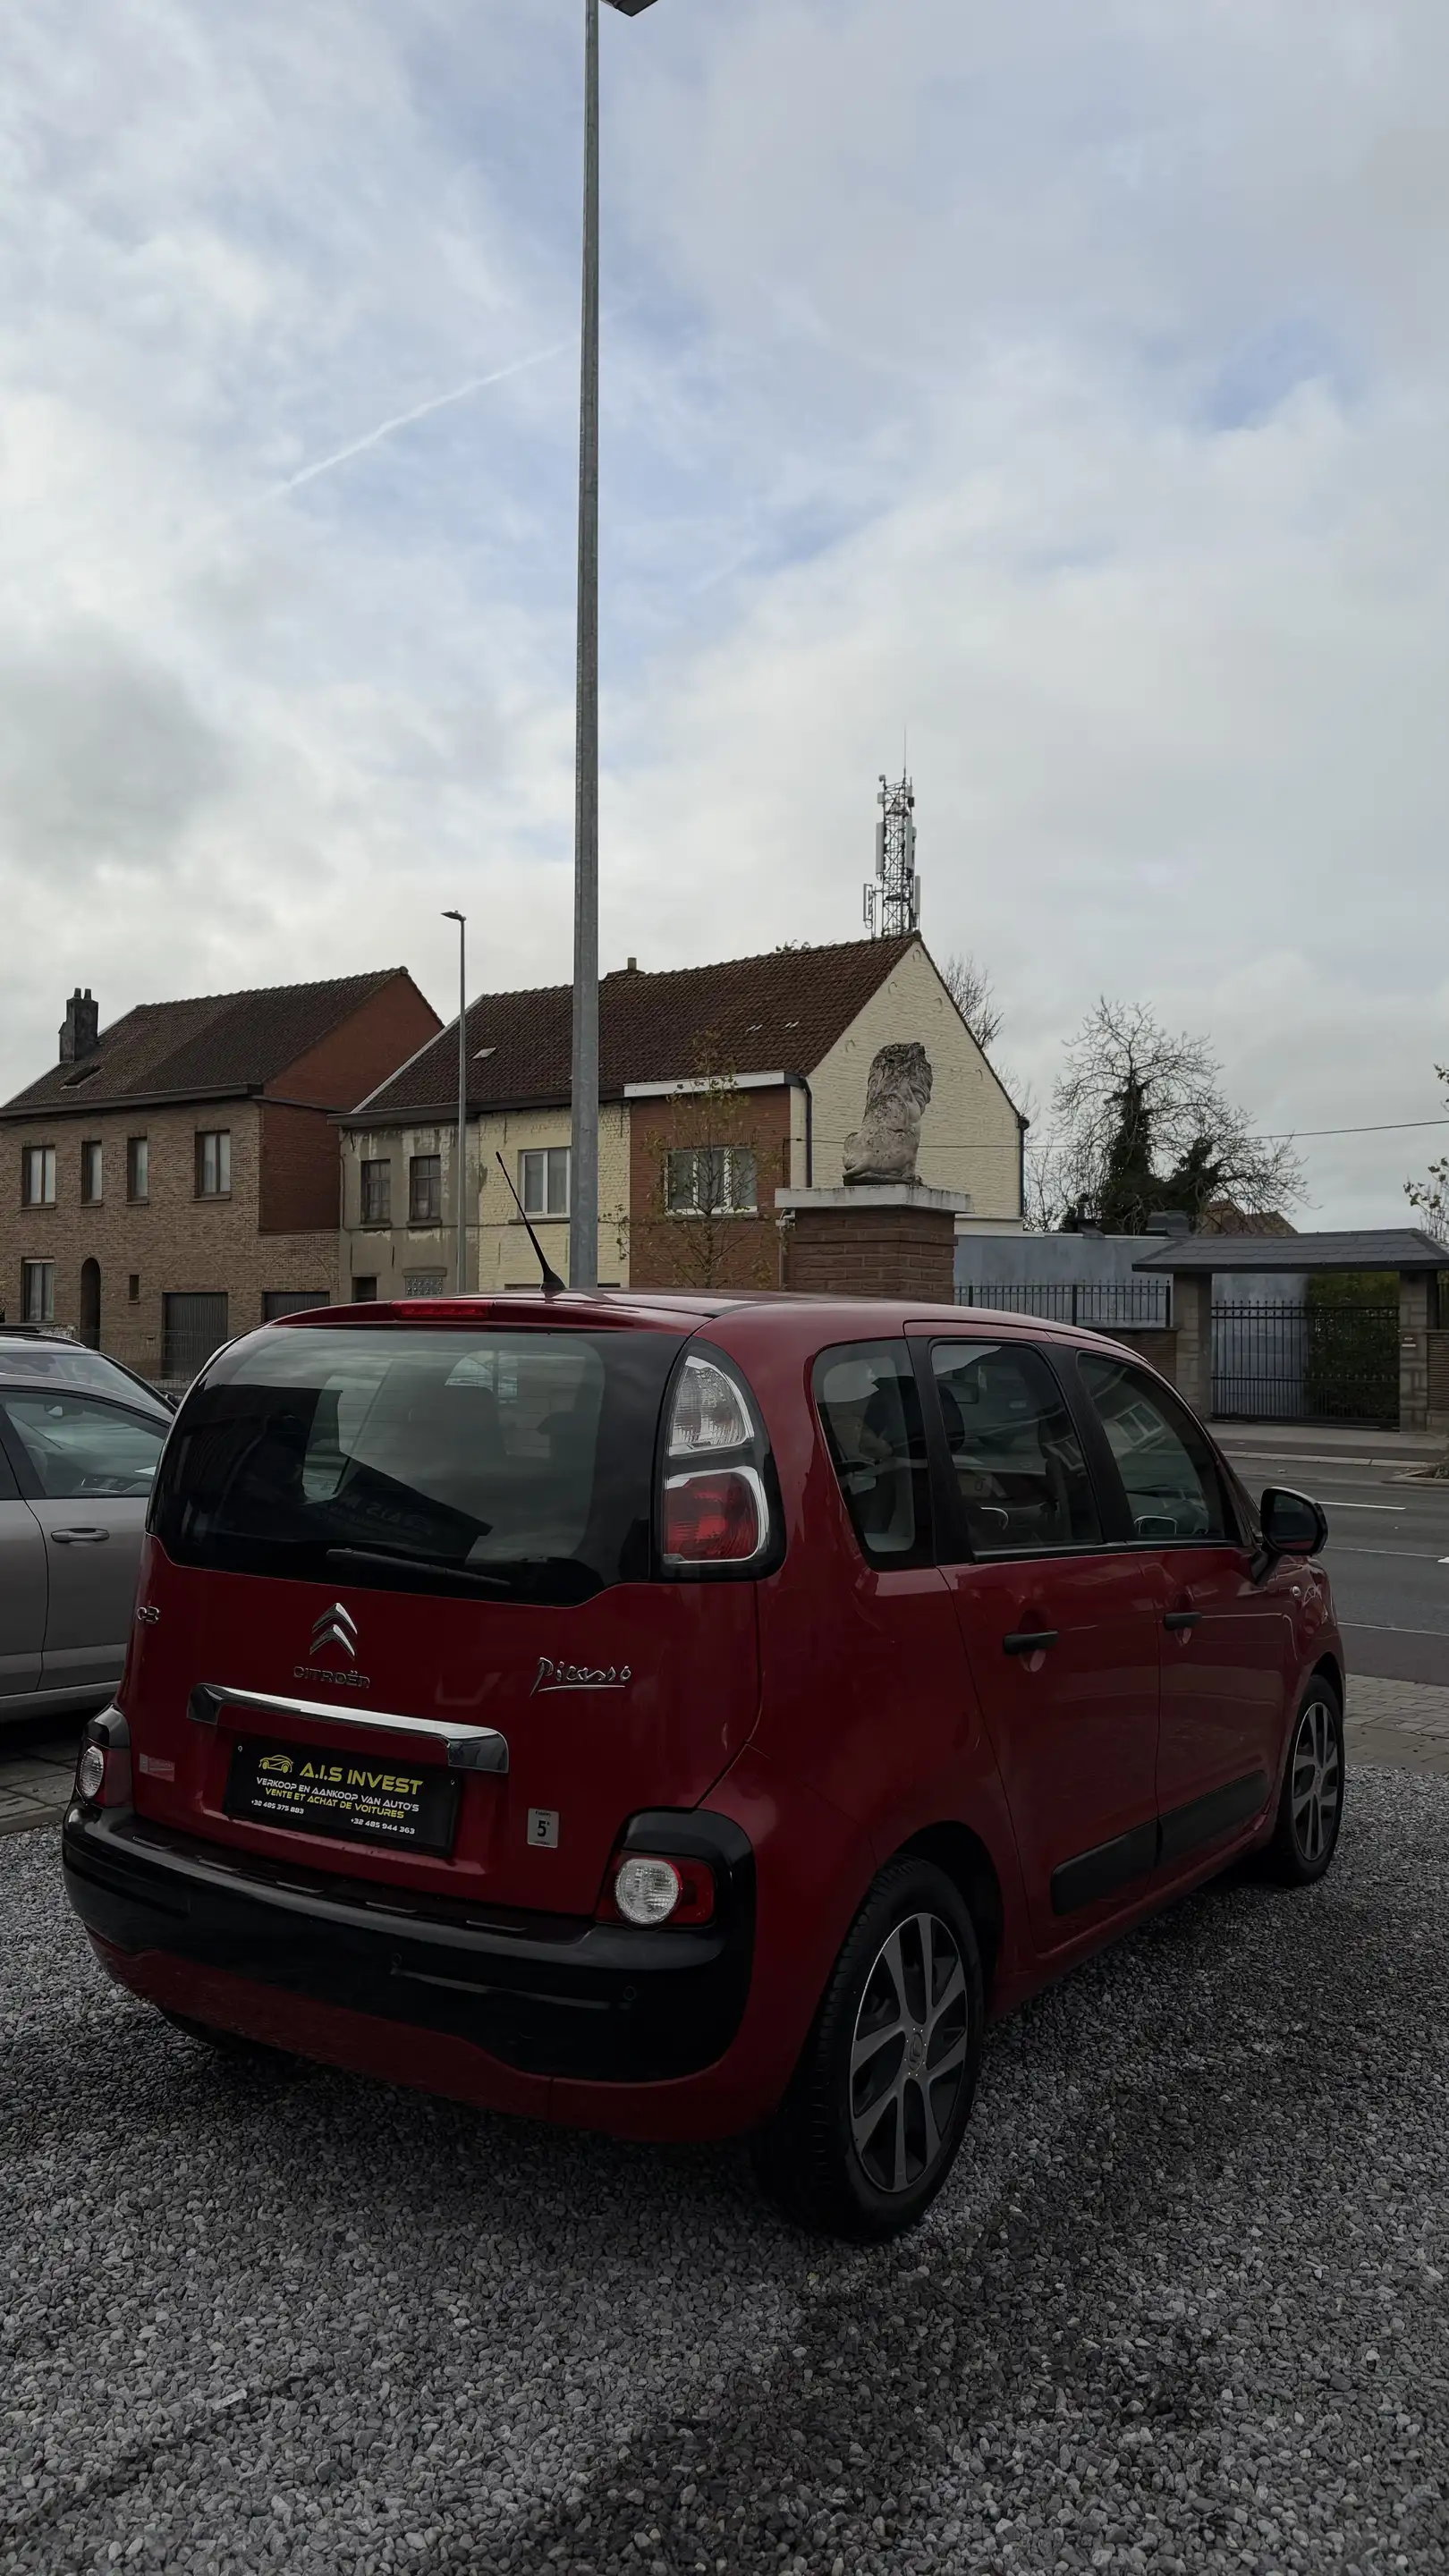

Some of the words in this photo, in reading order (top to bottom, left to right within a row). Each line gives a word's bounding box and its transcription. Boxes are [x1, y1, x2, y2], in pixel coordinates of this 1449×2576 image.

[137, 1606, 160, 1624] C3
[529, 1657, 631, 1698] Picasso
[256, 1776, 297, 1790] VERKOOP
[298, 1784, 310, 1793] EN
[311, 1786, 359, 1801] AANKOOP
[360, 1794, 381, 1806] VAN
[383, 1799, 419, 1812] AUTO'S
[299, 1762, 343, 1783] A.I.S
[346, 1768, 424, 1795] INVEST
[265, 1787, 293, 1799] VENTE
[293, 1792, 306, 1801] ET
[307, 1795, 338, 1807] ACHAT
[339, 1801, 352, 1809] DE
[354, 1802, 404, 1819] VOITURES
[351, 1818, 364, 1826] +32
[365, 1819, 381, 1828] 485
[381, 1823, 398, 1832] 944
[399, 1826, 416, 1835] 363
